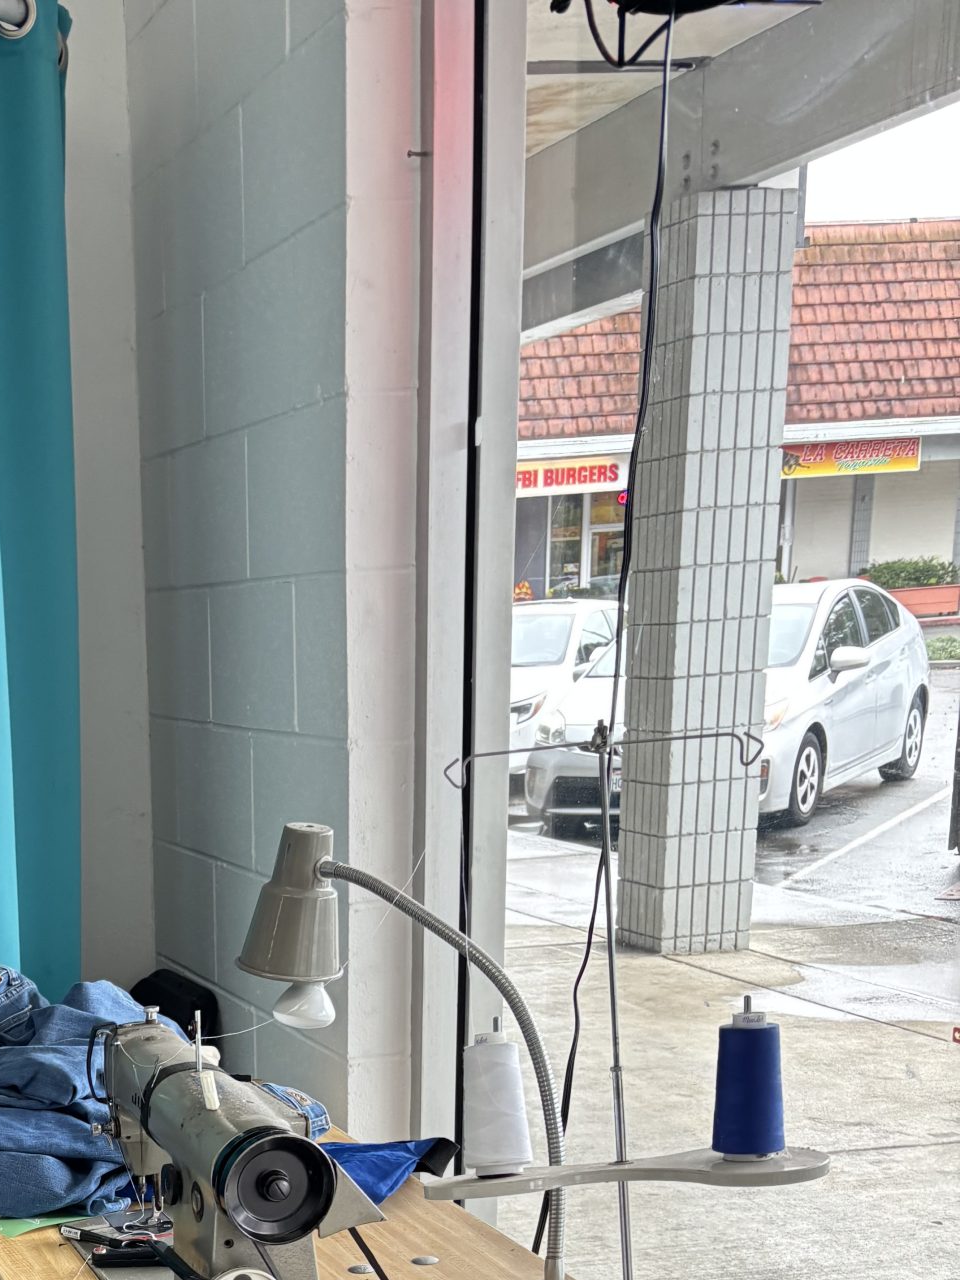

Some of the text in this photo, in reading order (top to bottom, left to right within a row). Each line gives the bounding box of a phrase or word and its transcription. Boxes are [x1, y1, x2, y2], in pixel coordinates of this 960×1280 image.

[801, 439, 918, 462] LA CARRETA
[543, 463, 619, 488] BURGERS
